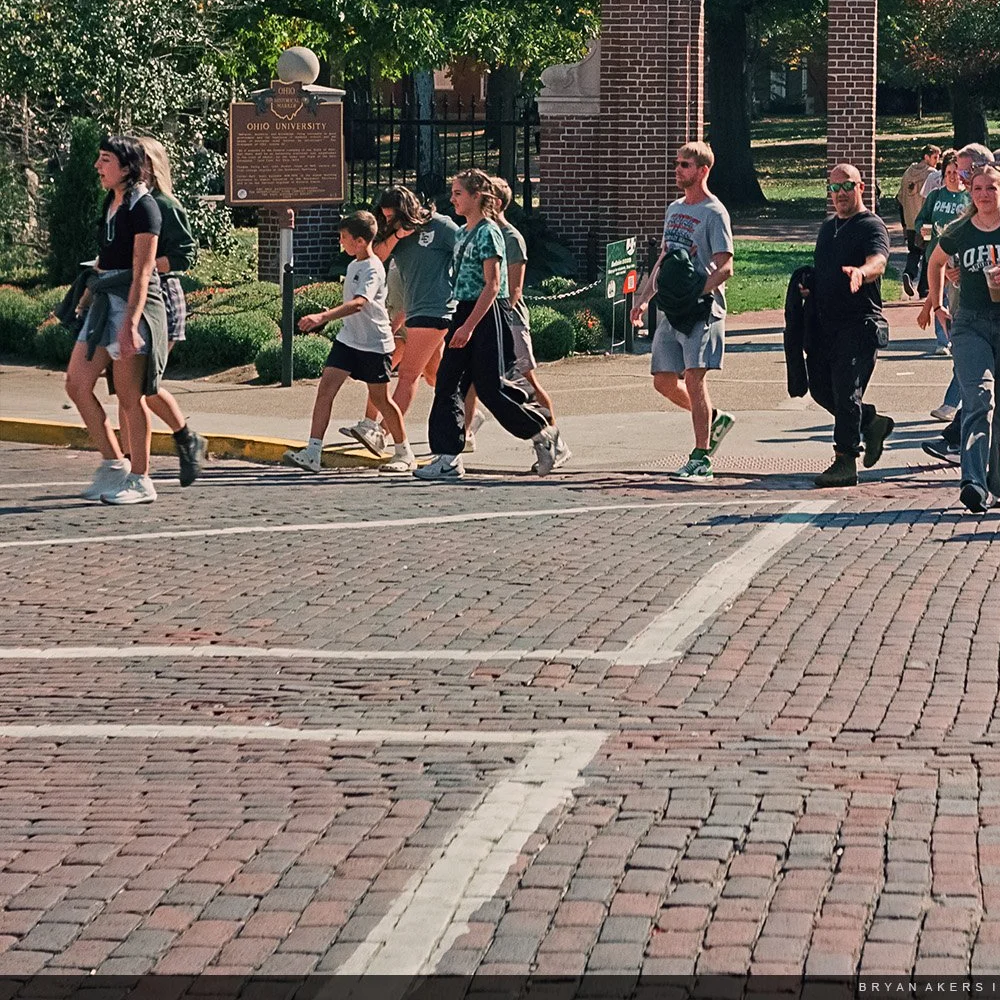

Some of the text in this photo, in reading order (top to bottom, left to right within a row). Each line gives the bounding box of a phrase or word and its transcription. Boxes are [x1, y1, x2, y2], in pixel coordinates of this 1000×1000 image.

[278, 86, 296, 95] OHIO
[246, 122, 327, 131] OHIO UNIVERSITY
